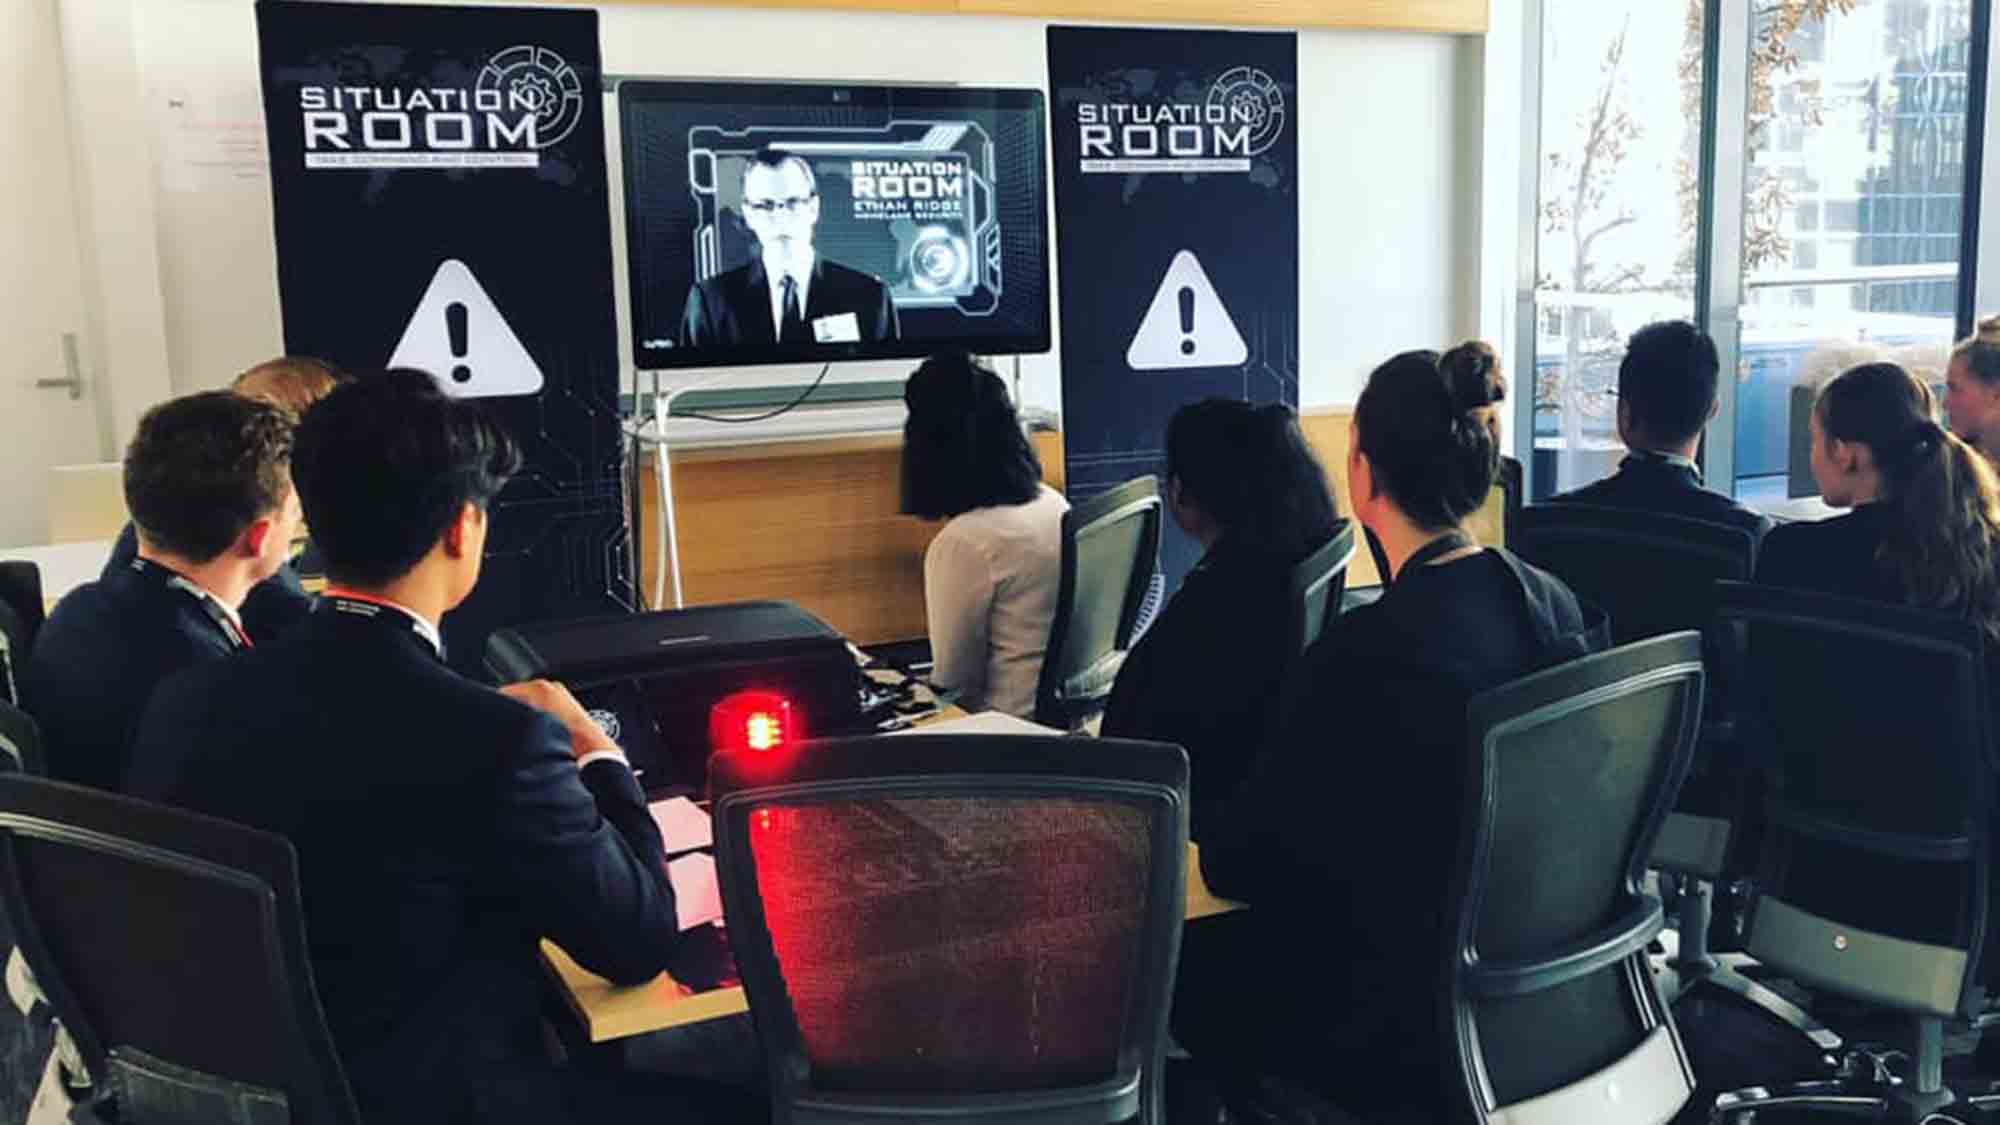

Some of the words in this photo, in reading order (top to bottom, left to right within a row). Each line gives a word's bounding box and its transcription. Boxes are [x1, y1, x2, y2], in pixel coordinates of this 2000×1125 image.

[301, 87, 536, 110] SITUATION
[1078, 103, 1250, 124] SITUATION
[303, 111, 538, 149] ROOM
[1080, 124, 1251, 156] ROOM
[852, 161, 962, 175] SITUATION
[852, 176, 963, 198] ROOM
[854, 200, 907, 211] ETHAN
